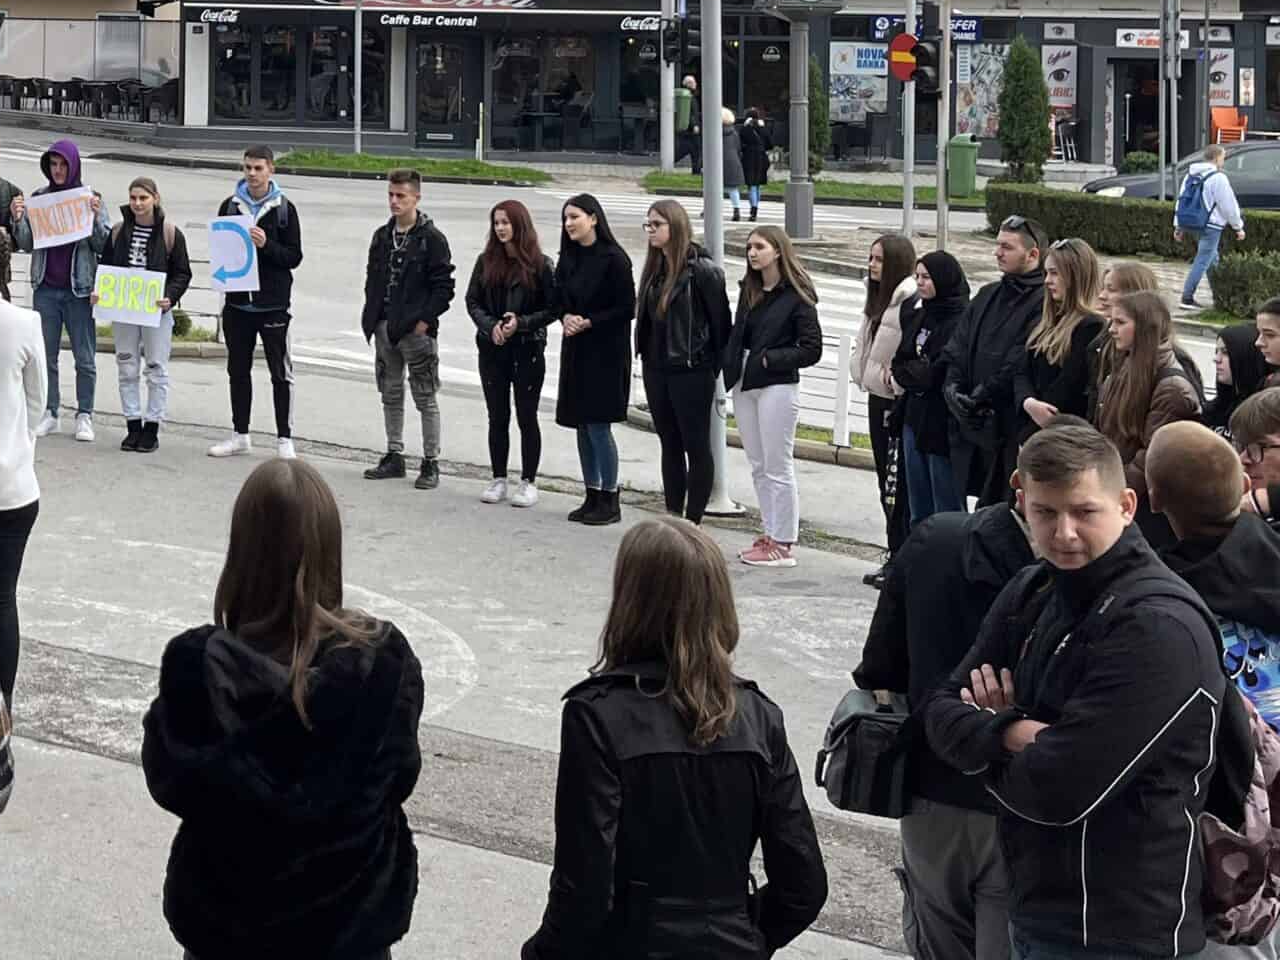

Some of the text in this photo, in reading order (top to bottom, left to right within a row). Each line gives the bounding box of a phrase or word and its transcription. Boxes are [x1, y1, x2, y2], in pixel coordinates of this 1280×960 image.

[380, 14, 478, 27] Caffe Bar Central
[856, 47, 884, 59] NOVA
[98, 273, 161, 313] BIRO
